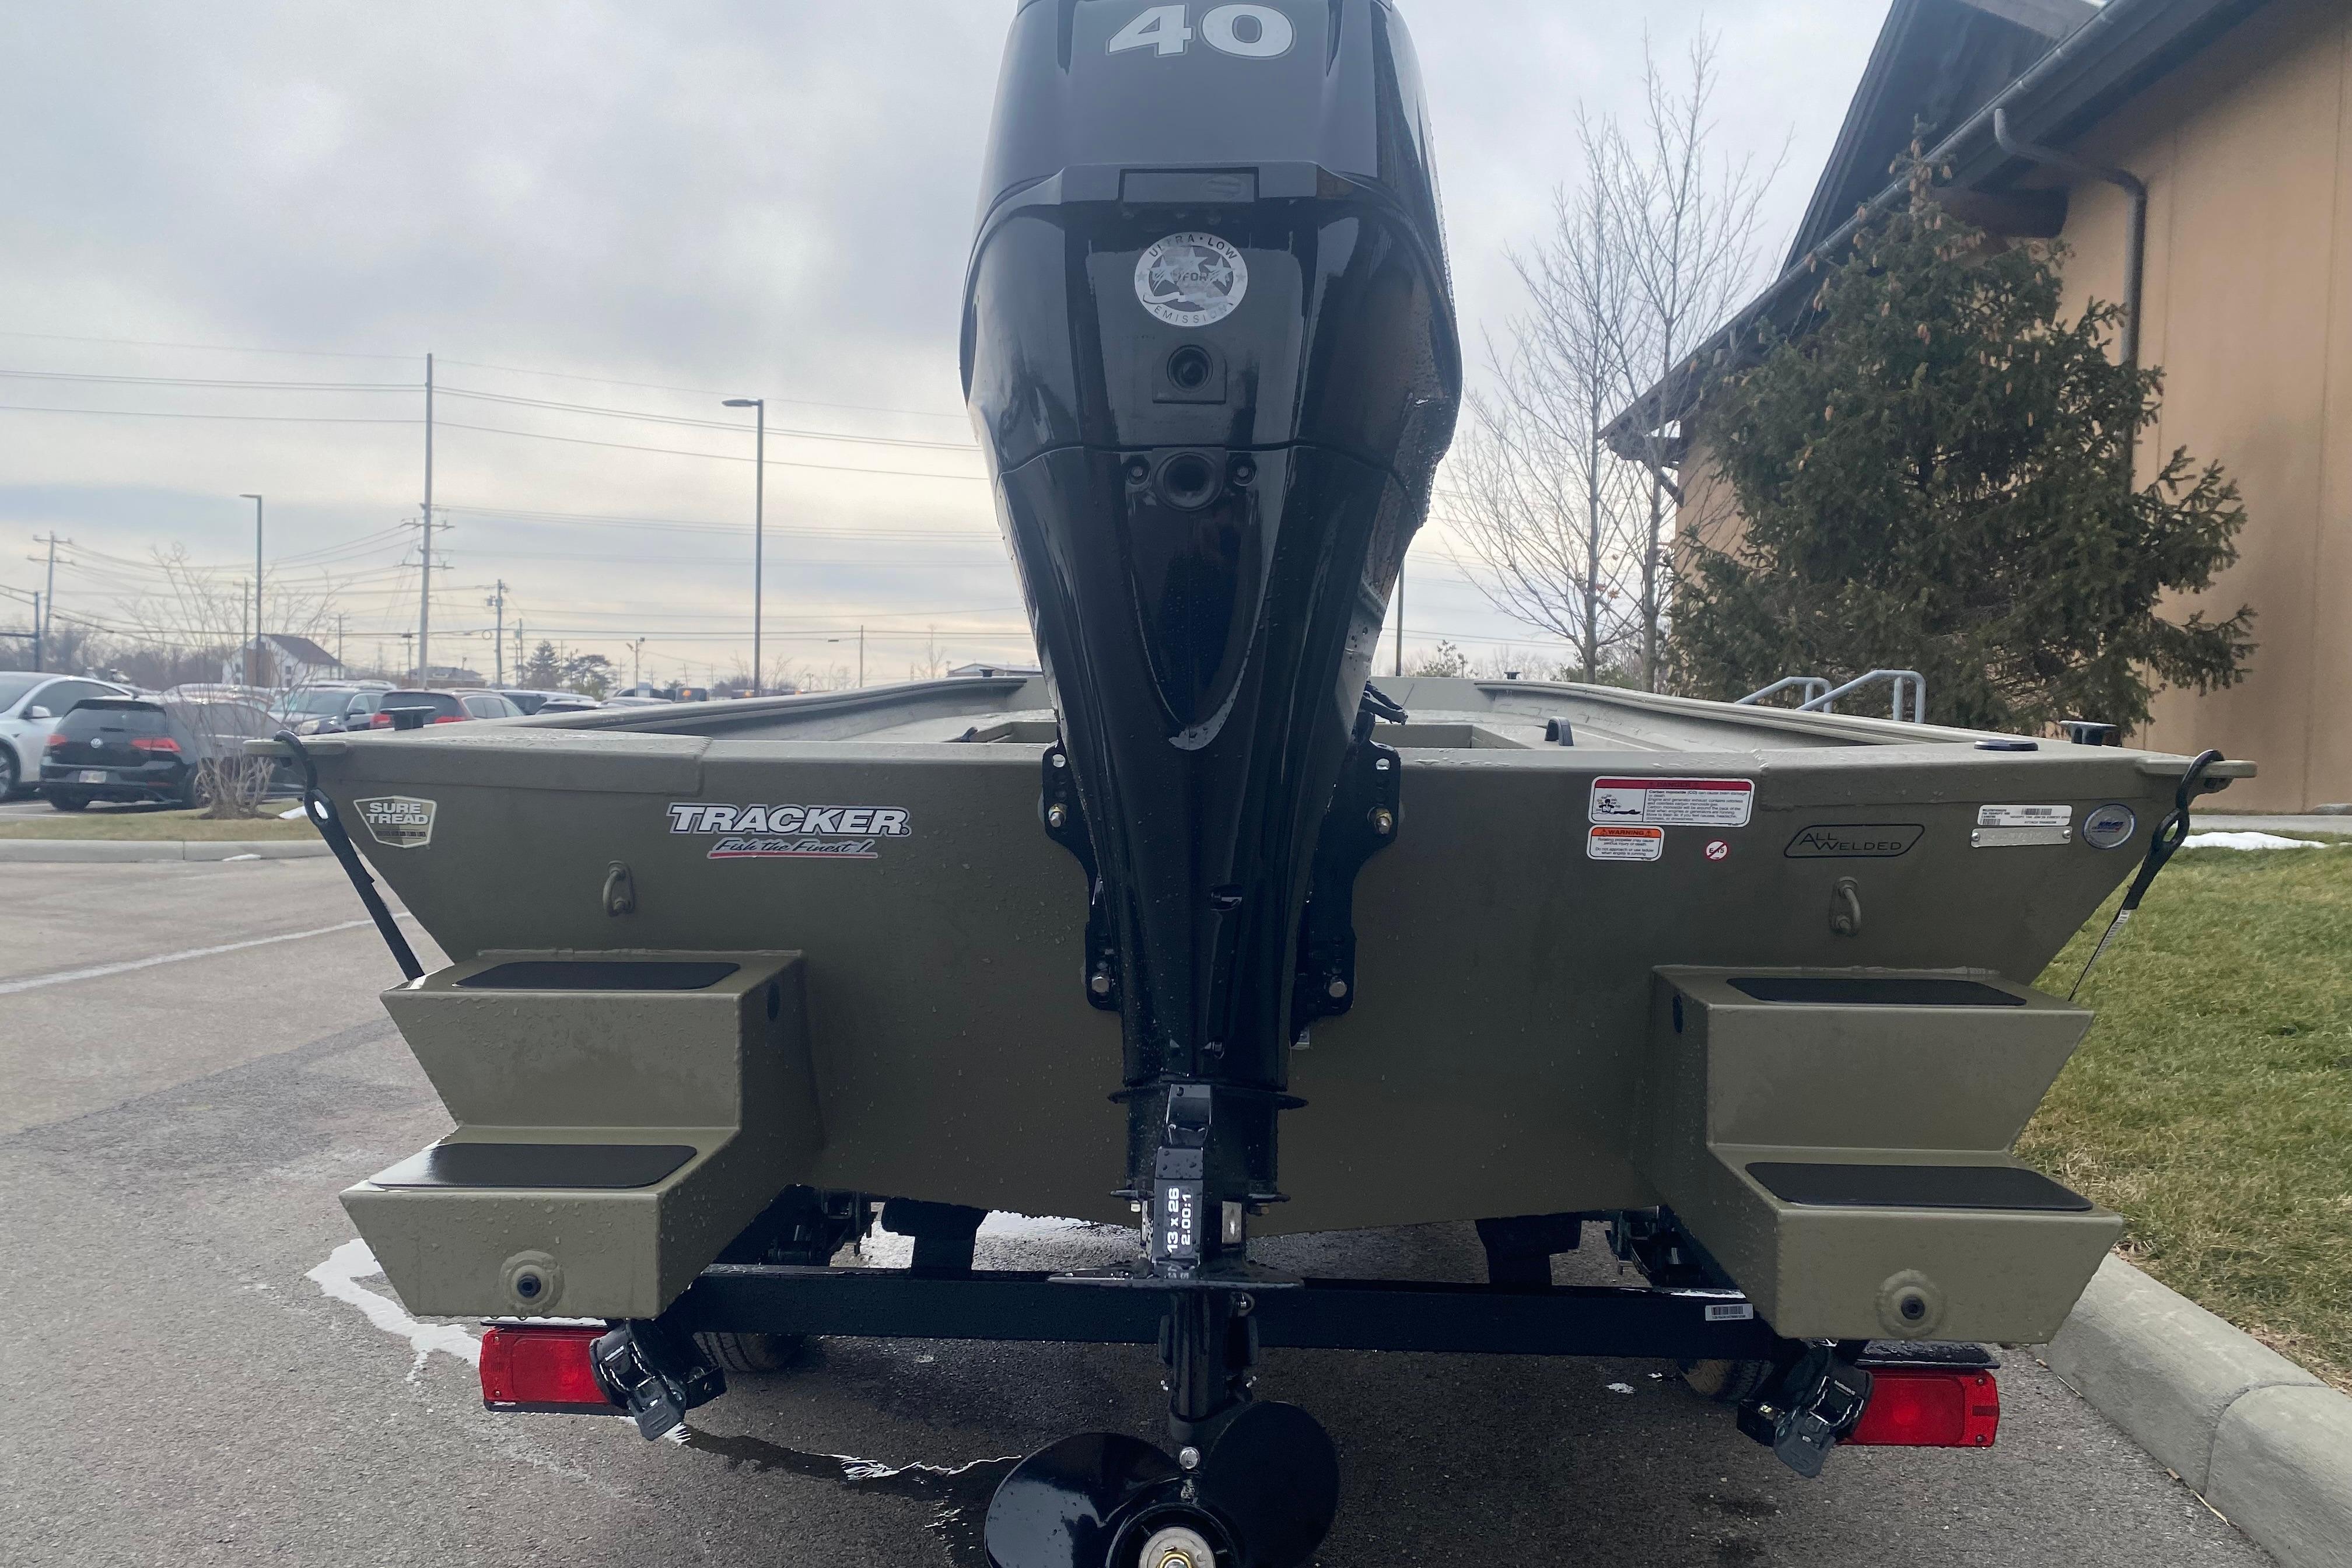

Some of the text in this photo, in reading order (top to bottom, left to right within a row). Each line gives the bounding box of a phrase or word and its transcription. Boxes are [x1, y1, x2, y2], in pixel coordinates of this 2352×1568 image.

[1107, 2, 1295, 58] 40
[1149, 234, 1238, 260] URA LOW
[366, 813, 428, 825] TREAD
[369, 802, 421, 814] SURE
[669, 804, 904, 835] TRACKER
[715, 840, 757, 850] Fish
[760, 842, 790, 852] the
[1799, 832, 1838, 846] ALL
[1815, 842, 1902, 850] WELDED
[1168, 1188, 1180, 1213] 26
[1181, 1194, 1192, 1245] 2.00:1
[1167, 1231, 1179, 1254] 13
